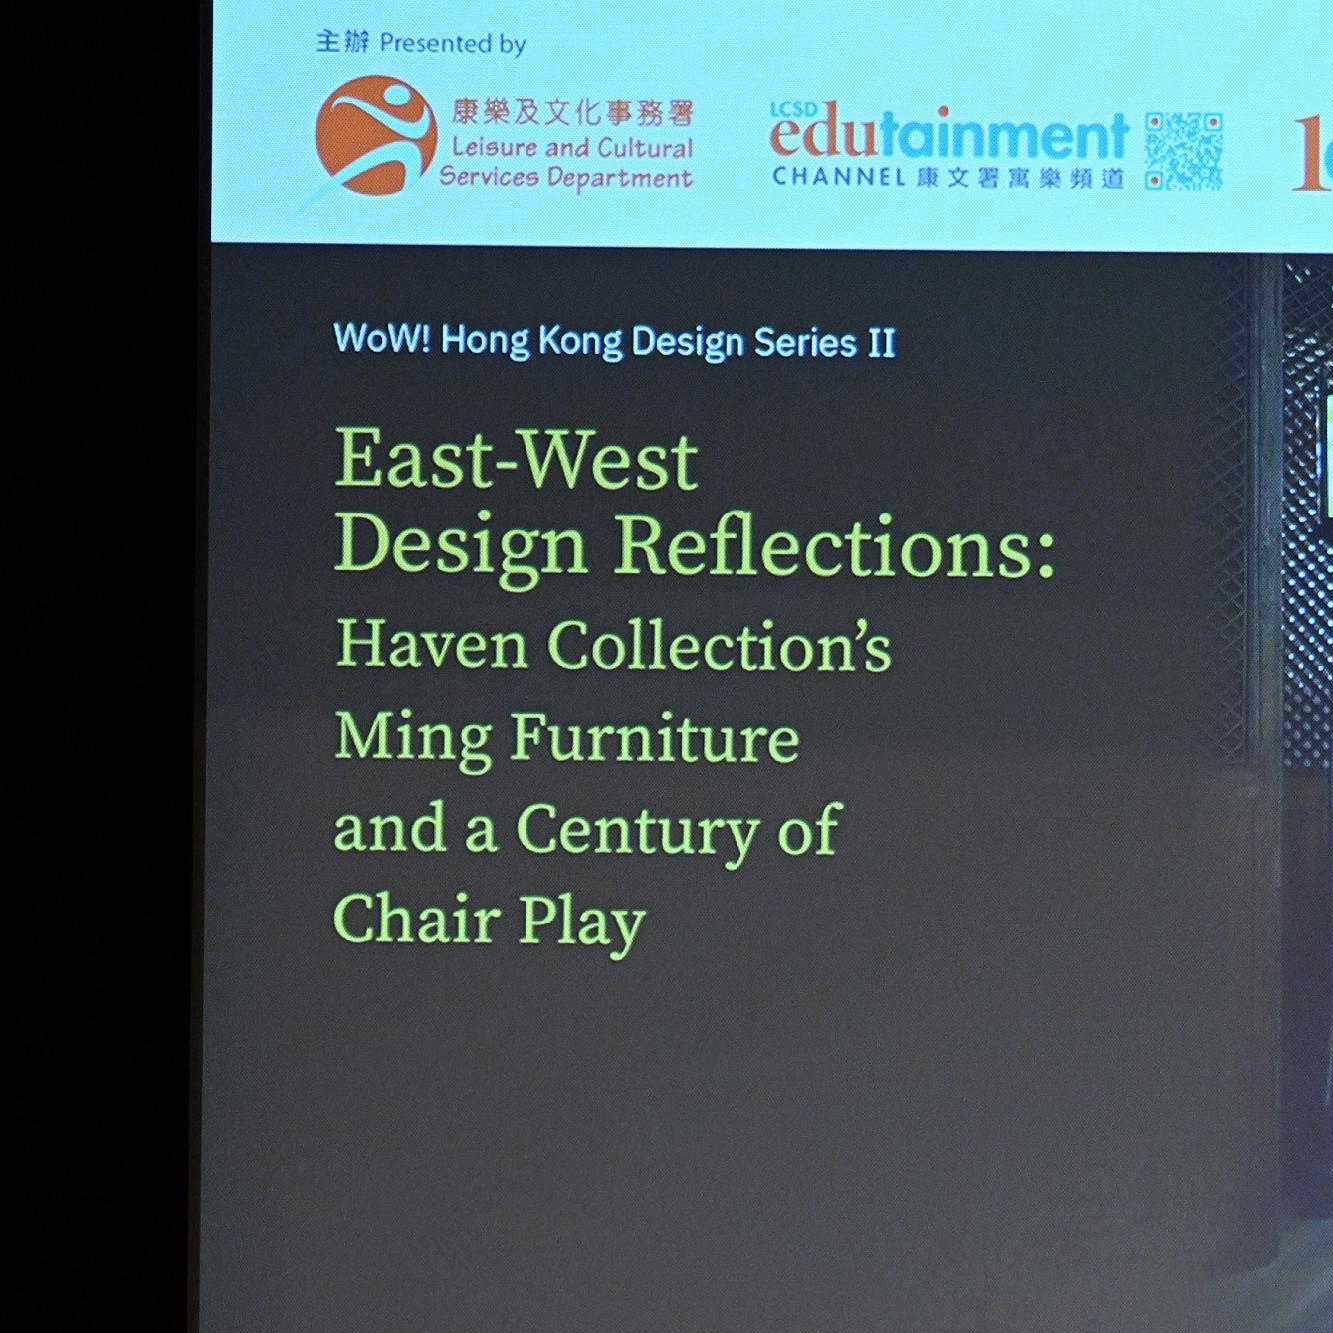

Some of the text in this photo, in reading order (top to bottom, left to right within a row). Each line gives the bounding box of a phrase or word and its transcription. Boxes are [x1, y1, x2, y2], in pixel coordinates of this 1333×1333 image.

[317, 29, 526, 58] 主辦 Presented by
[453, 97, 693, 126] 康樂及文化事務署
[769, 100, 1130, 159] edutainment
[770, 100, 818, 118] LCSD
[453, 136, 692, 158] Leisure and Cultural
[440, 165, 693, 195] Services Department
[773, 166, 905, 186] CHANNEL
[334, 322, 895, 364] WoW! Hong Kong Design Series II
[335, 427, 698, 490] East-West
[334, 510, 1053, 592] Design Reflections:
[337, 617, 891, 672] Haven Collection’s
[335, 708, 799, 775] Ming Furniture
[335, 799, 844, 870] and a Century of
[334, 891, 646, 961] Chair Play
